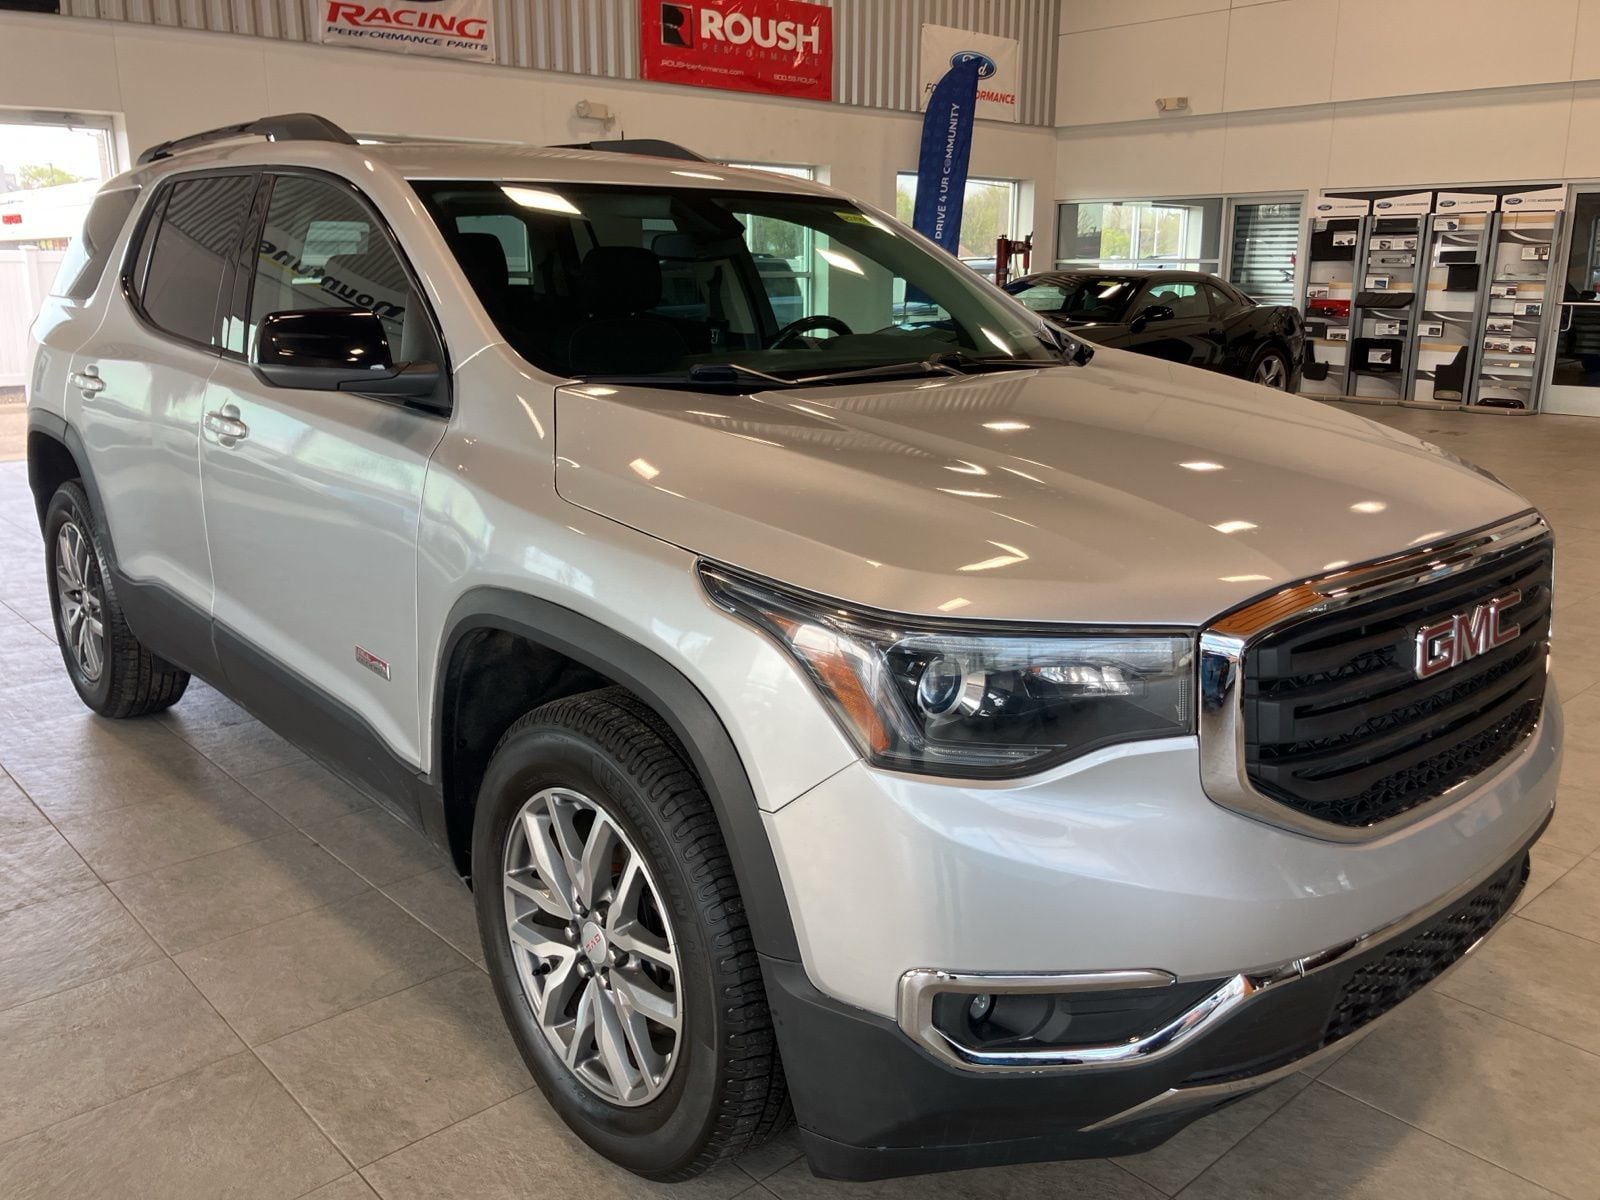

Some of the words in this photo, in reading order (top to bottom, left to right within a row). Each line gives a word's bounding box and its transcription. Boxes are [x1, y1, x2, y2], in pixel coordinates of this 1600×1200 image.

[326, 1, 488, 39] RACING
[700, 8, 819, 54] ROUSH
[327, 26, 443, 46] PERFORMANCE
[446, 40, 488, 51] PARTS
[975, 90, 1016, 105] ORMANCE
[943, 103, 960, 174] COMMUNITY
[939, 195, 947, 203] 4
[940, 177, 949, 192] UR
[935, 205, 946, 239] DRIVE
[1415, 589, 1521, 680] GMC
